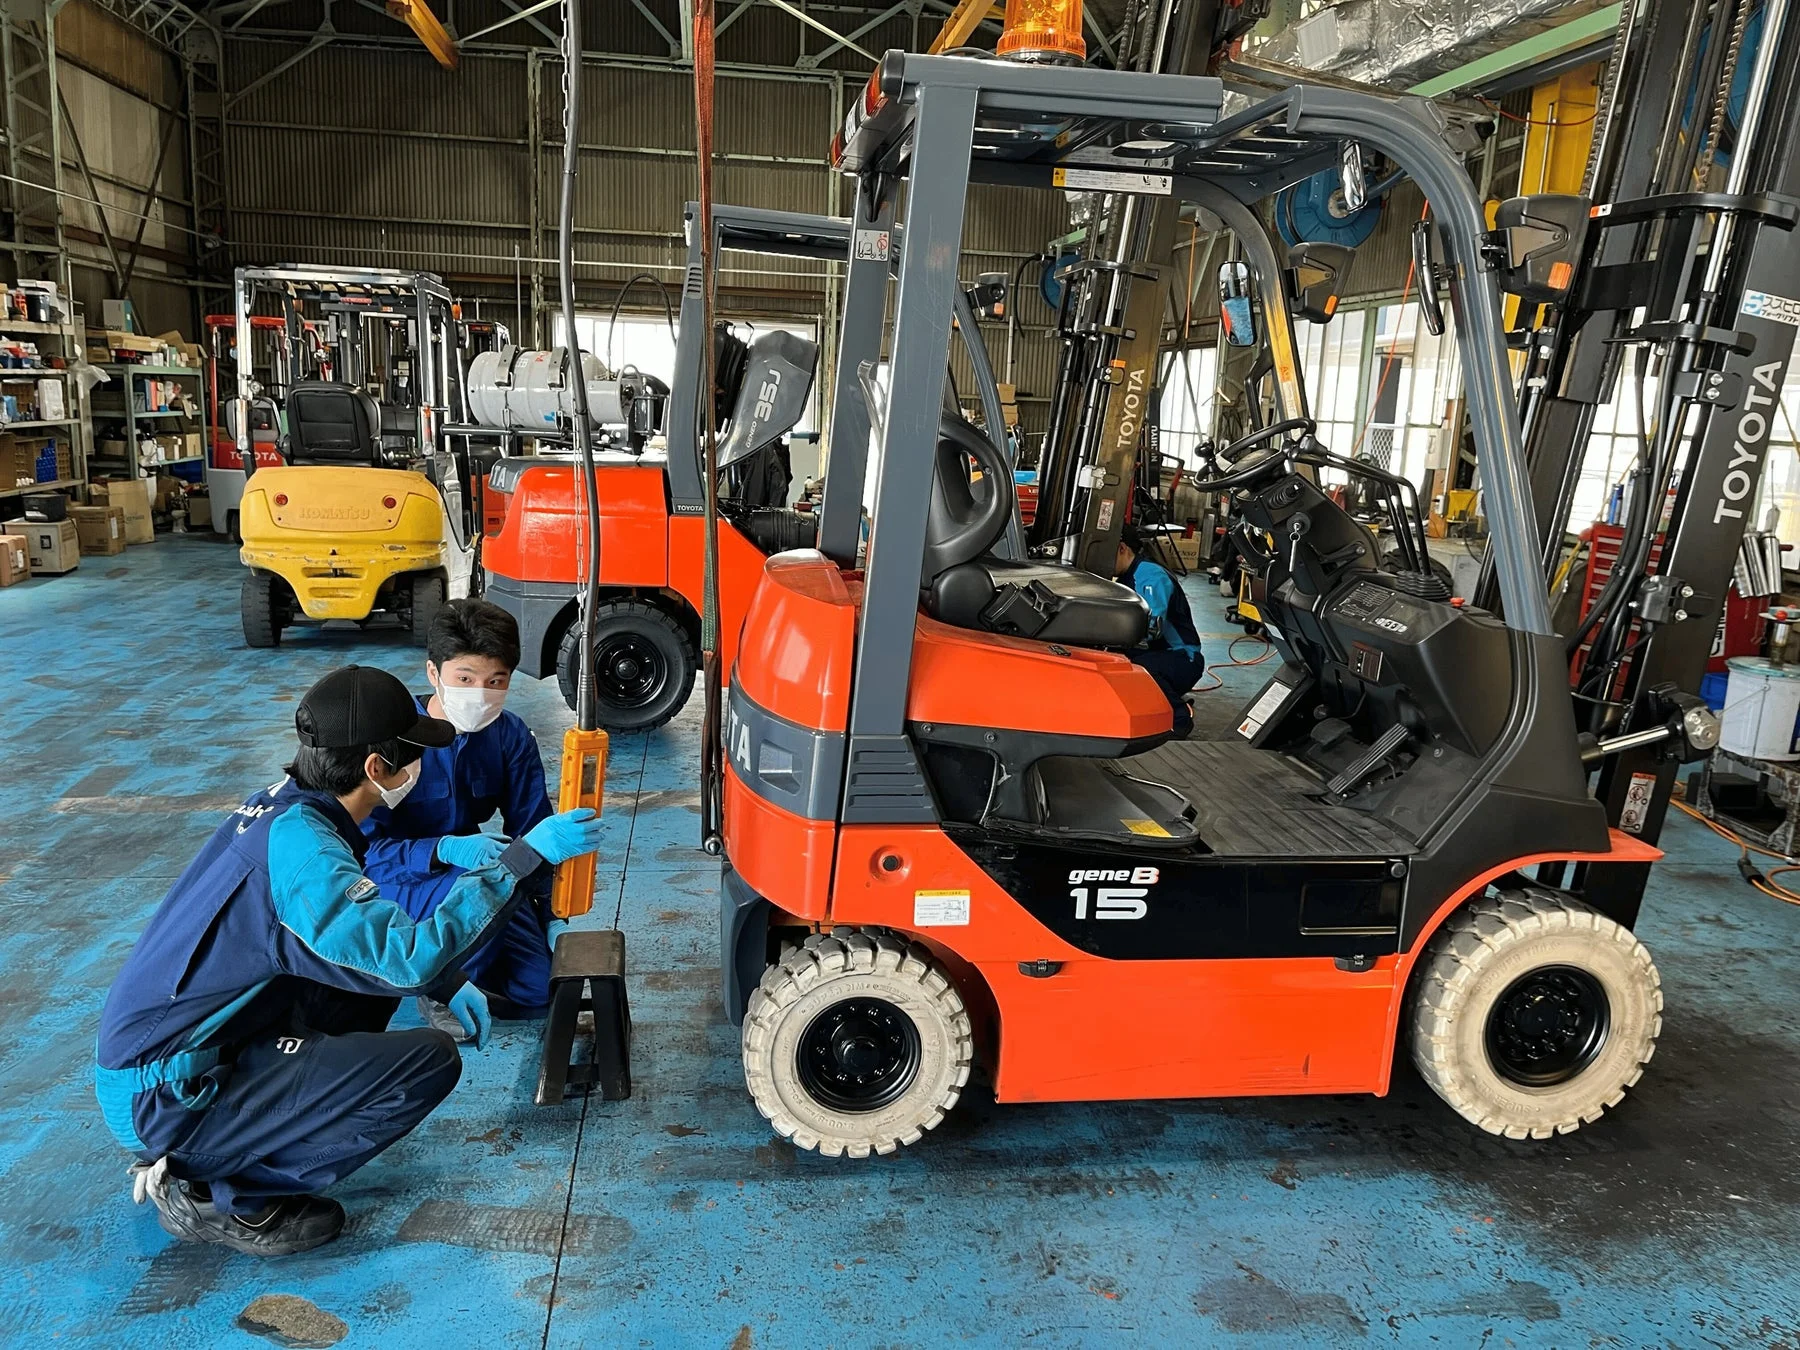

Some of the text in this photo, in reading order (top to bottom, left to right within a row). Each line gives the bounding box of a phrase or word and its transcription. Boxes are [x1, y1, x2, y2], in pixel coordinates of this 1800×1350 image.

[754, 369, 782, 422] 35J
[1116, 368, 1146, 449] TOYOTA
[230, 450, 278, 462] TOOTA
[1713, 361, 1783, 524] TOYOTA
[299, 508, 371, 520] KOMATSU
[677, 504, 704, 512] TOYOTA
[727, 699, 751, 773] TA
[1067, 866, 1160, 885] geneB
[1069, 887, 1149, 920] 15
